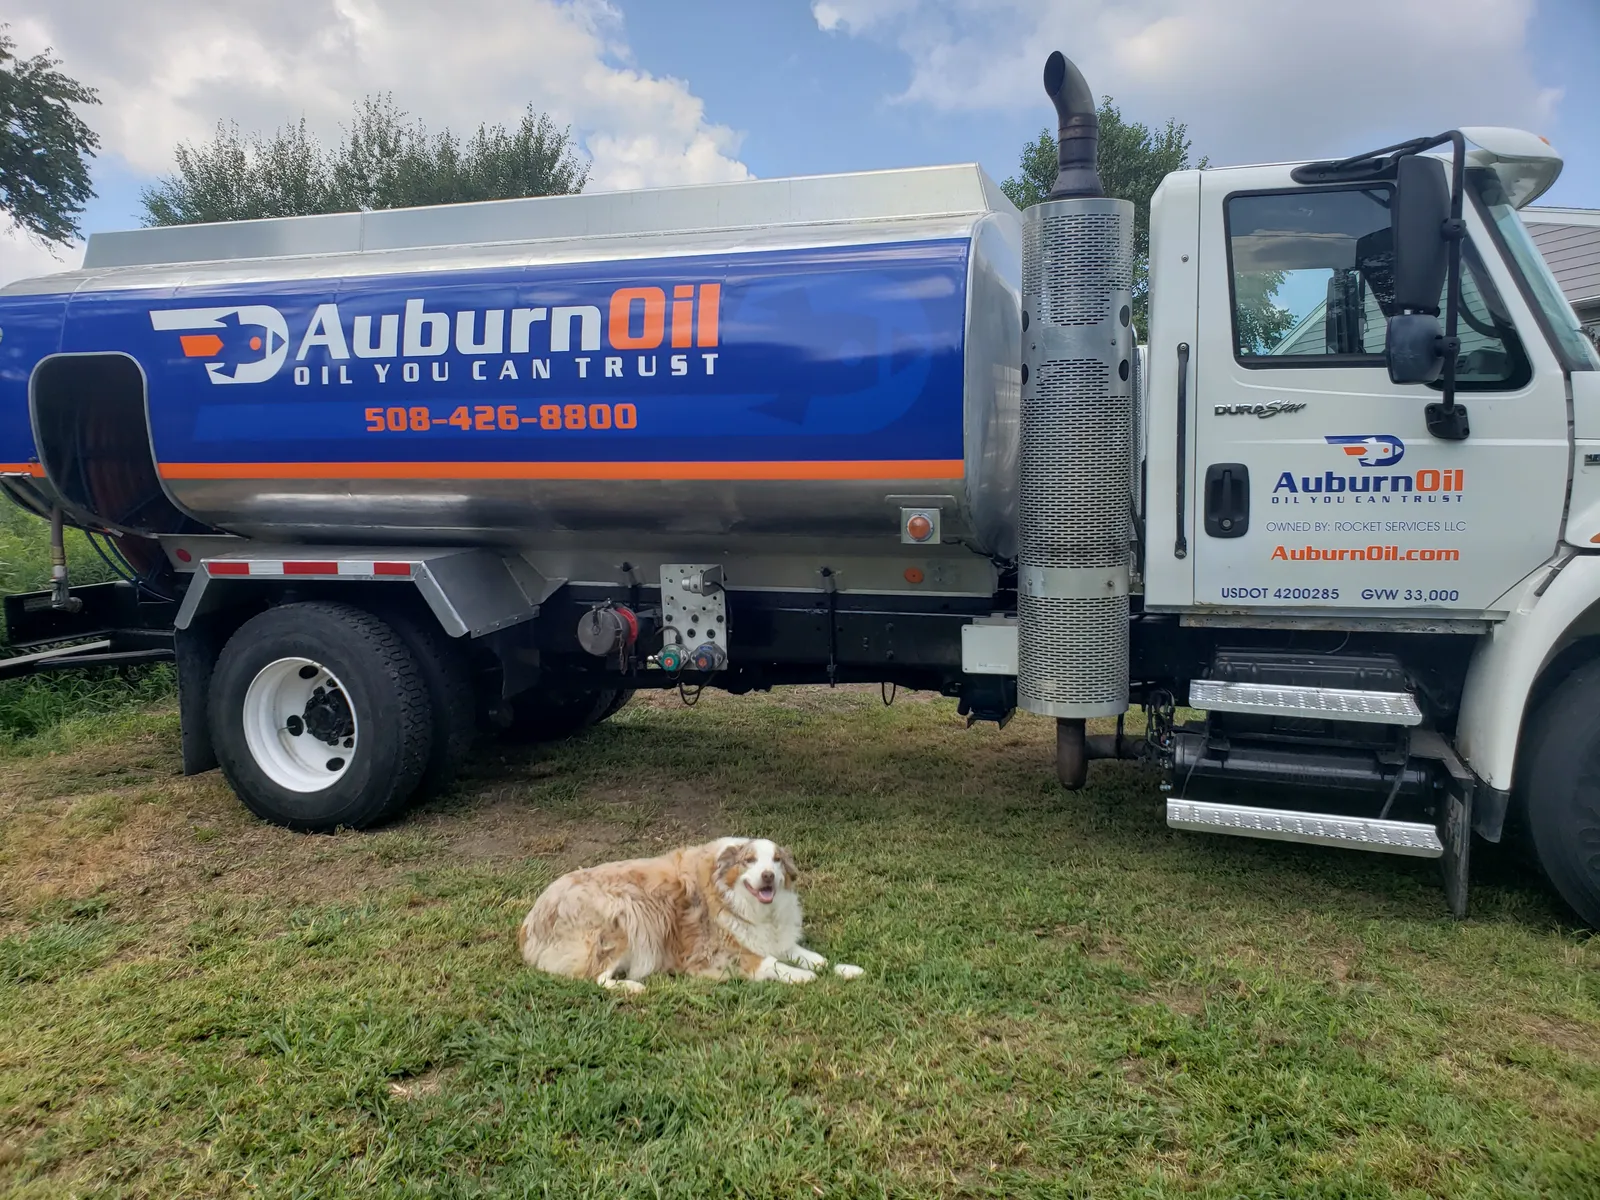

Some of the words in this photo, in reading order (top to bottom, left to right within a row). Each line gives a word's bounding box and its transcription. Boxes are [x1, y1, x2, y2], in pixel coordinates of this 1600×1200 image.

[295, 283, 721, 361] AuburnOil
[294, 365, 353, 386] OIL
[373, 361, 449, 384] YOU
[472, 358, 551, 381] CAN
[574, 353, 719, 378] TRUST
[364, 403, 638, 432] 508-426-8800
[1272, 469, 1464, 494] AuburnOil
[1271, 496, 1300, 504] OIL
[1310, 496, 1345, 504] YOU
[1355, 495, 1391, 504] CAN
[1401, 494, 1464, 503] TRUST
[1266, 521, 1311, 532] OWNED
[1314, 521, 1331, 532] BY:
[1334, 521, 1382, 532] ROCKET
[1385, 521, 1441, 532] SERVICES
[1444, 521, 1467, 532] LLC
[1270, 545, 1460, 562] AuburnOil.com
[1221, 587, 1269, 599] USDOT
[1273, 588, 1340, 600] 4200285
[1361, 589, 1399, 600] GVW
[1403, 589, 1460, 603] 33,000
